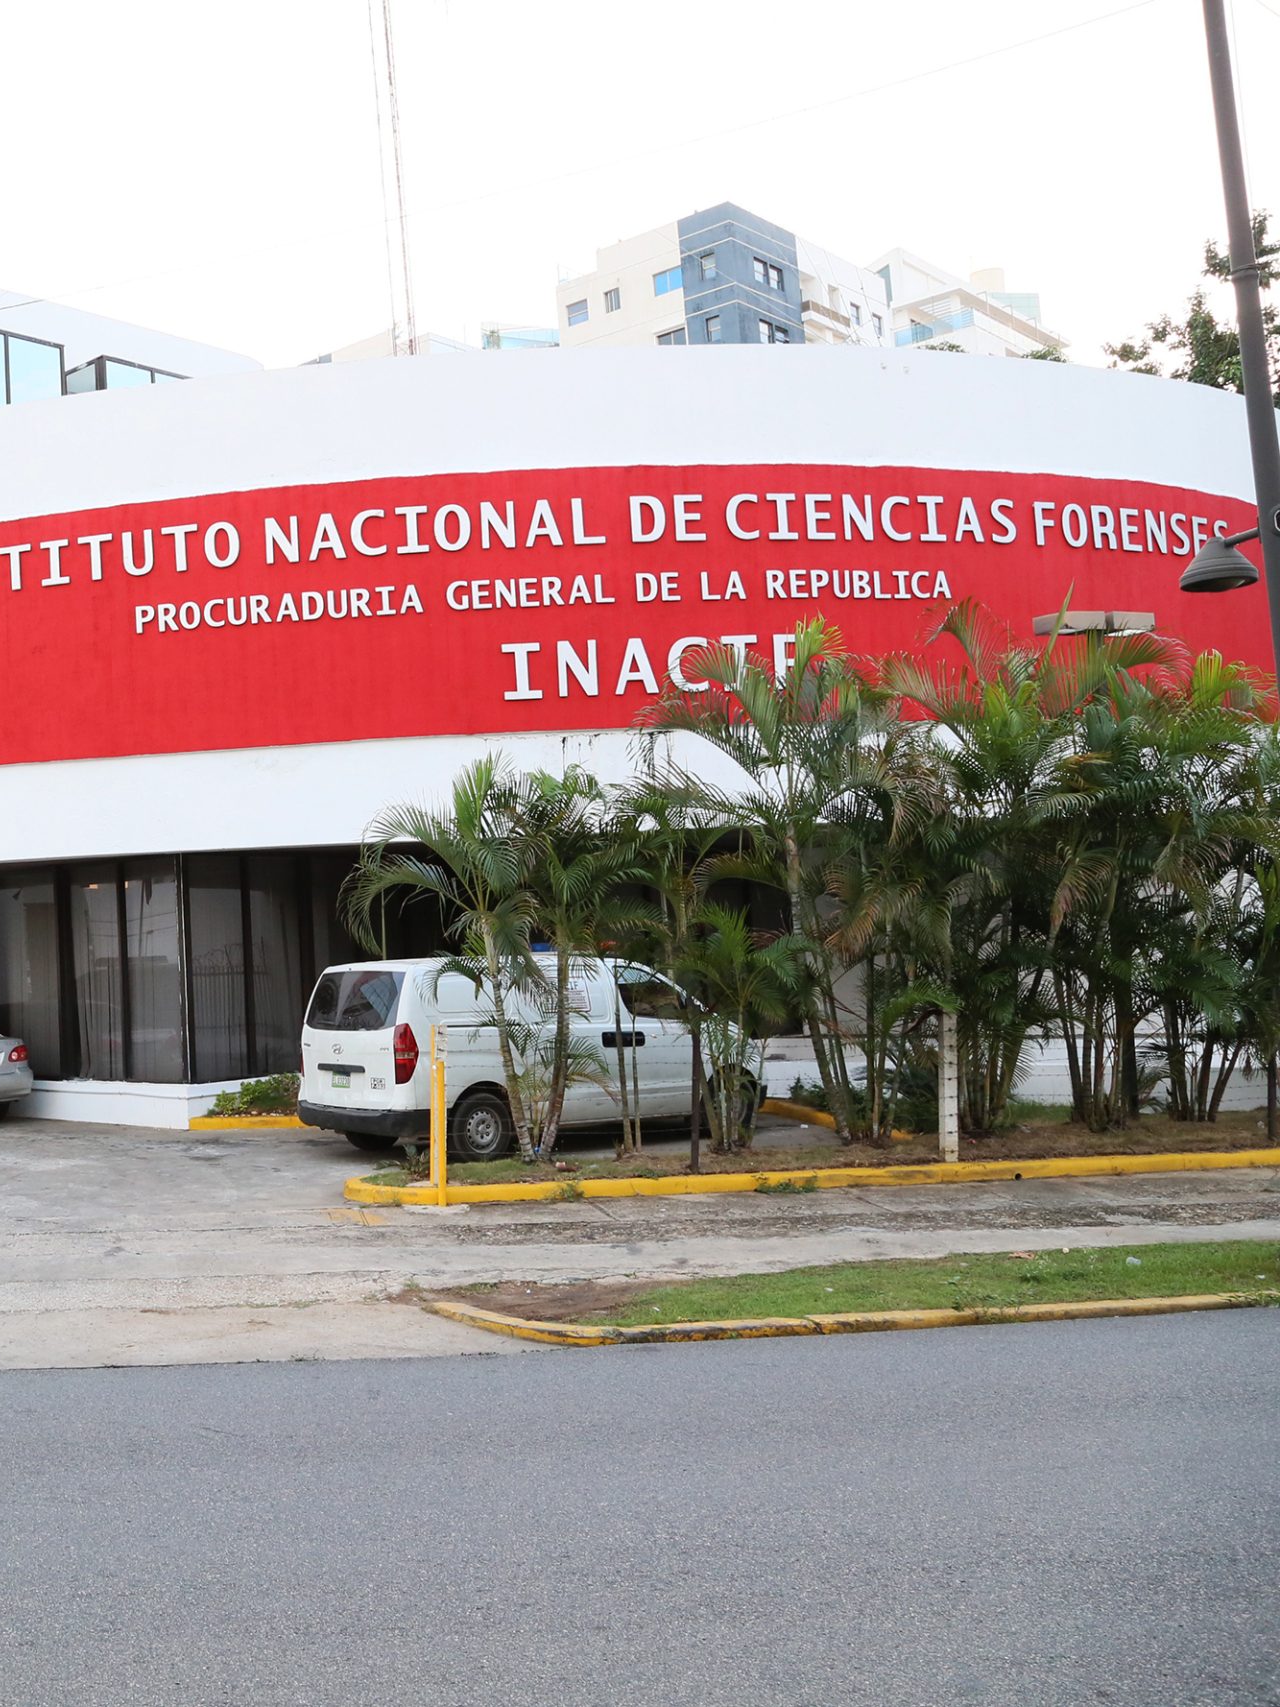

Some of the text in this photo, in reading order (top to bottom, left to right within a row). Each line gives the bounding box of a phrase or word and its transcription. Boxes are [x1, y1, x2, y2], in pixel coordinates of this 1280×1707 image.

[264, 497, 607, 564] NACIONAL
[629, 494, 707, 543] DE
[725, 492, 1017, 544] CIENCIAS
[135, 569, 952, 634] PROCURADURIA GENERAL DE LA REPUBLICA
